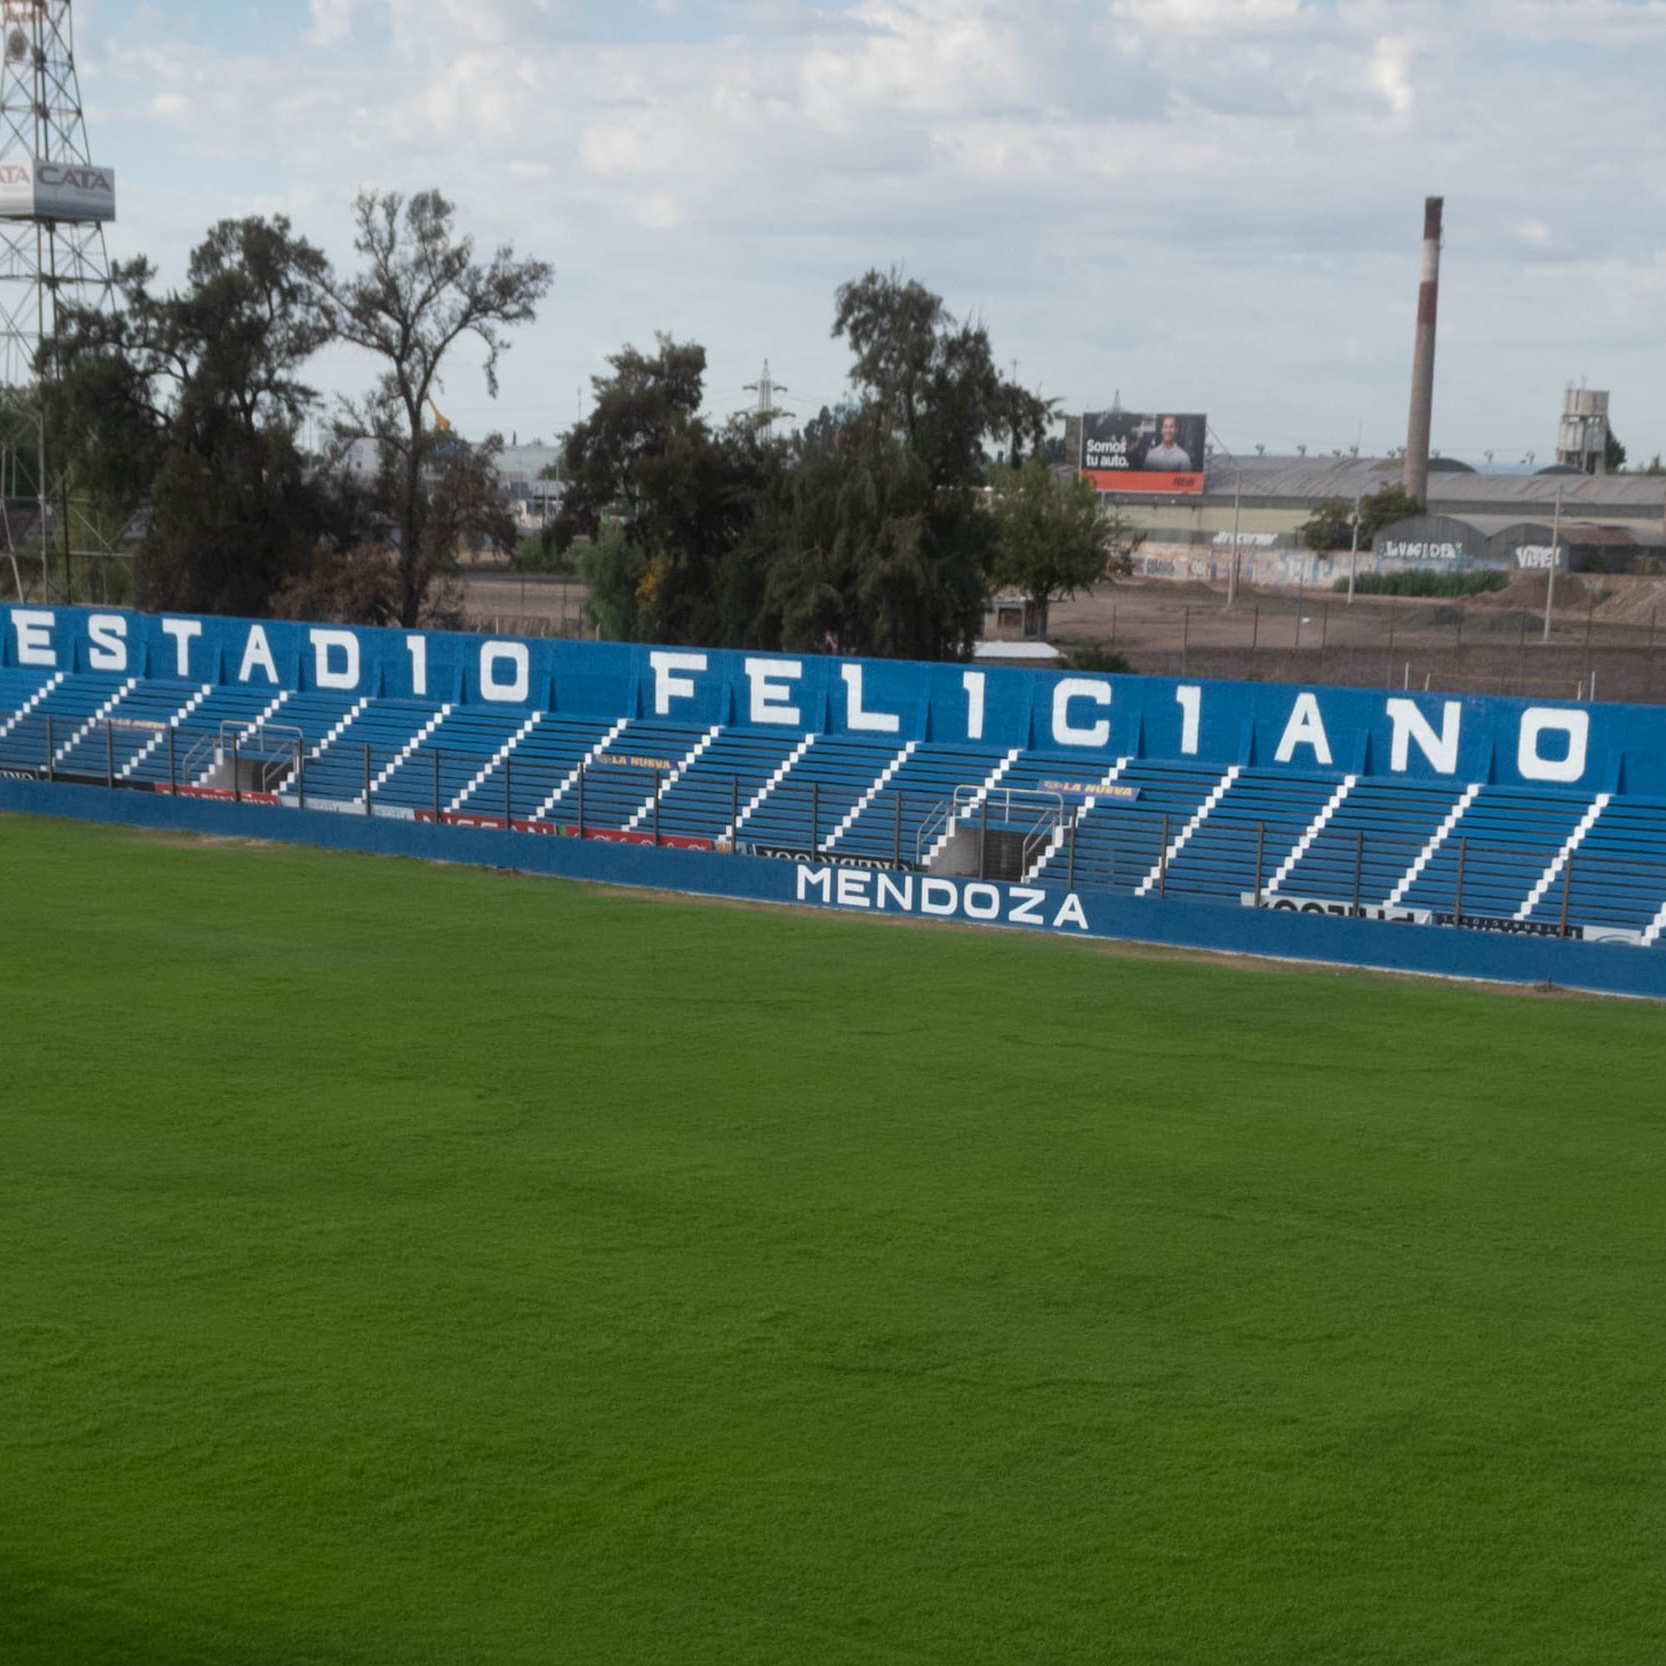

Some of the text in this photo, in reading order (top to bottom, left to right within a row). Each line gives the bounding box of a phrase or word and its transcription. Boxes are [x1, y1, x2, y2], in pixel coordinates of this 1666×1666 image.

[36, 166, 112, 192] CATA
[1086, 438, 1127, 453] Somos
[1086, 454, 1129, 468] tu auto.
[10, 609, 529, 702] ESTADIO
[649, 651, 1590, 782] FELICIANO
[612, 755, 671, 769] LA NUEVA
[1063, 782, 1132, 796] LA NUEVA
[796, 864, 1089, 930] MENDOZA
